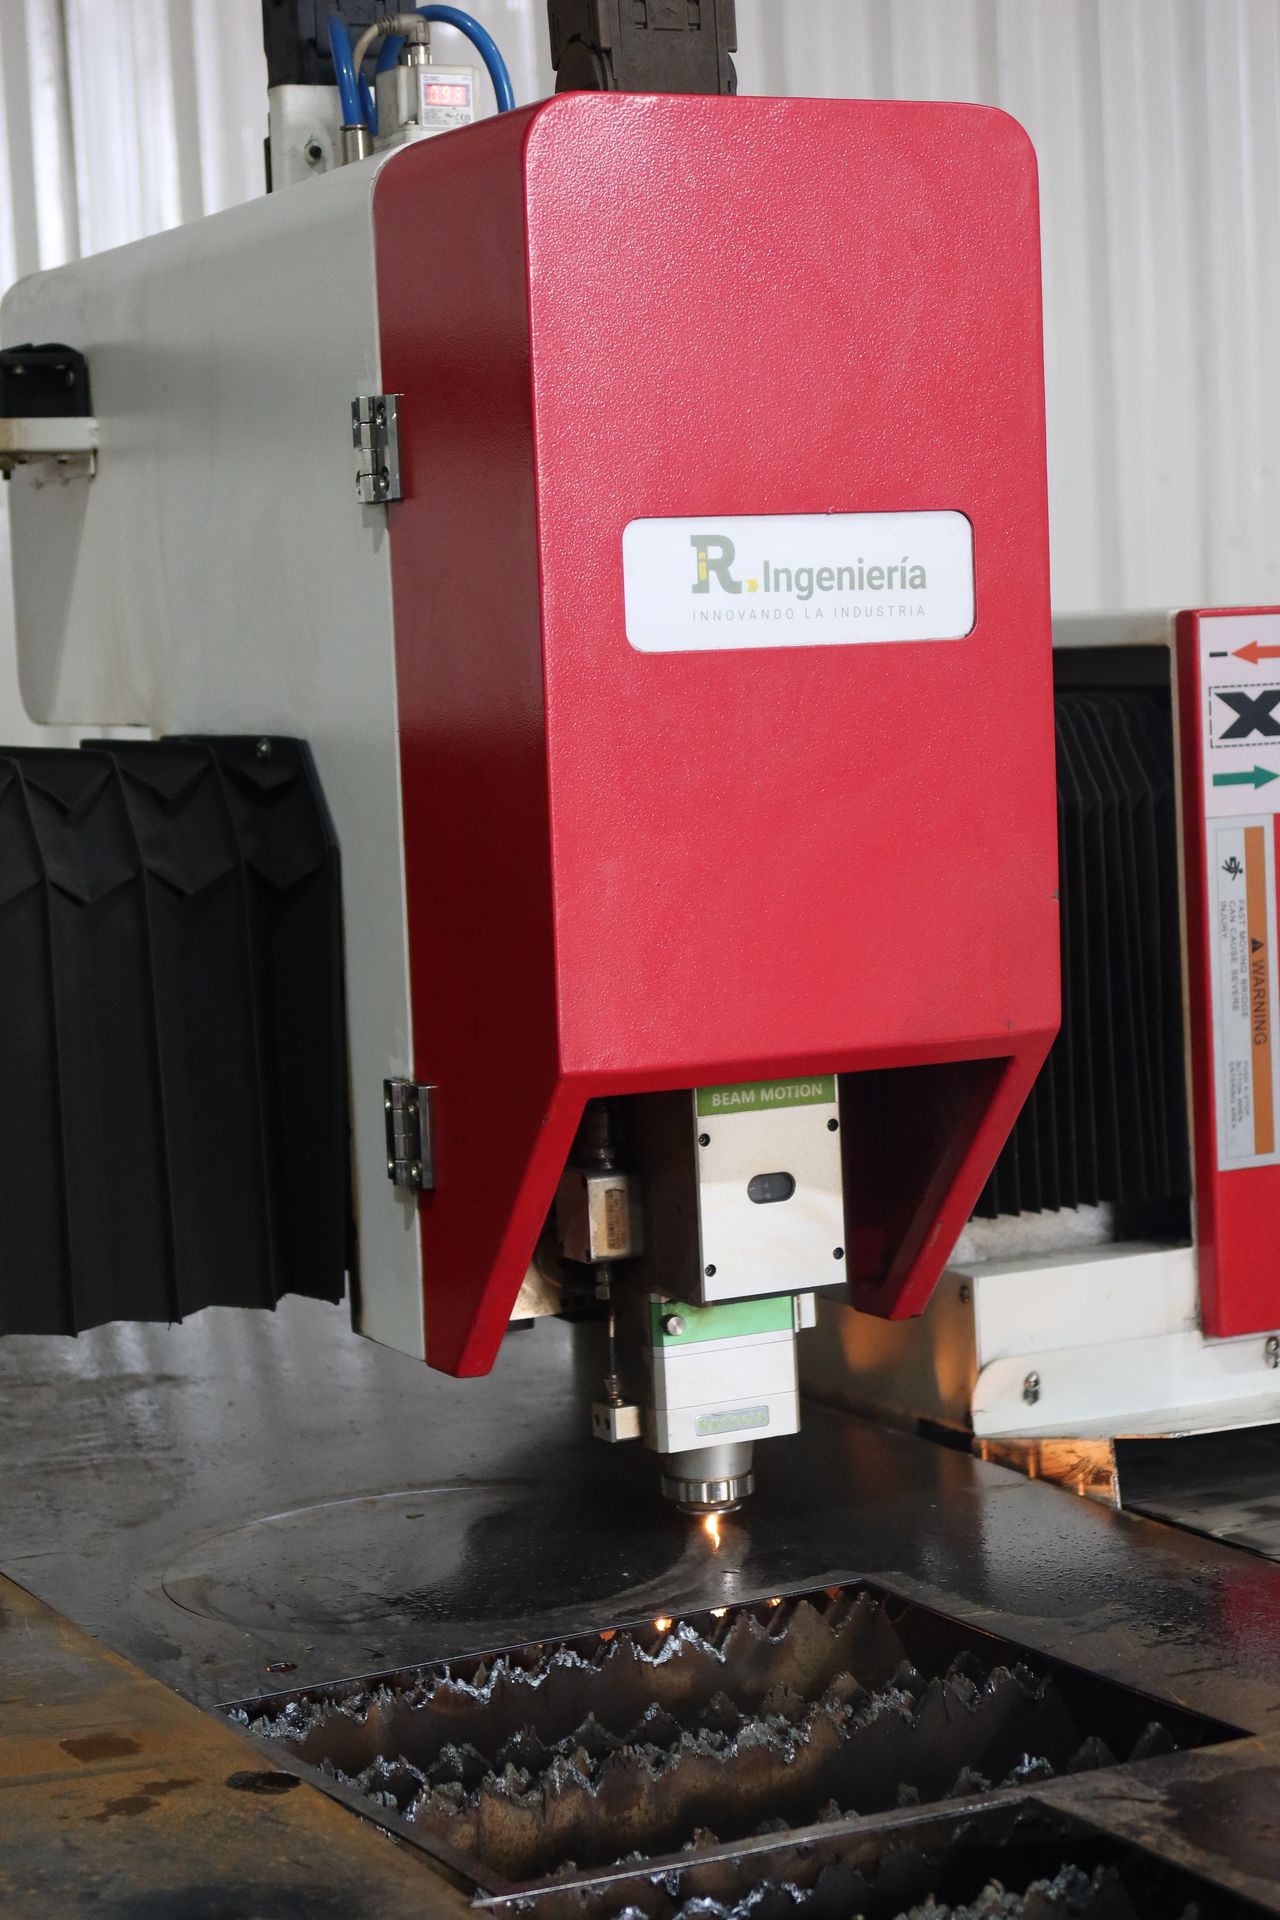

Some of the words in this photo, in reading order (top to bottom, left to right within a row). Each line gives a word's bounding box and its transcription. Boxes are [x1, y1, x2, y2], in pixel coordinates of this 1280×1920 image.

[763, 556, 927, 601] Ingeniería
[692, 608, 795, 623] INNOVANDO
[804, 606, 825, 620] LA
[833, 604, 926, 619] INDUSTRIA
[1220, 901, 1228, 939] INJURY
[1228, 902, 1237, 924] CAN
[1230, 929, 1239, 964] CAUSE
[1239, 931, 1248, 973] MOVING
[1251, 958, 1267, 1046] WARNING
[711, 1089, 755, 1107] BEAM
[760, 1083, 823, 1102] MOTION
